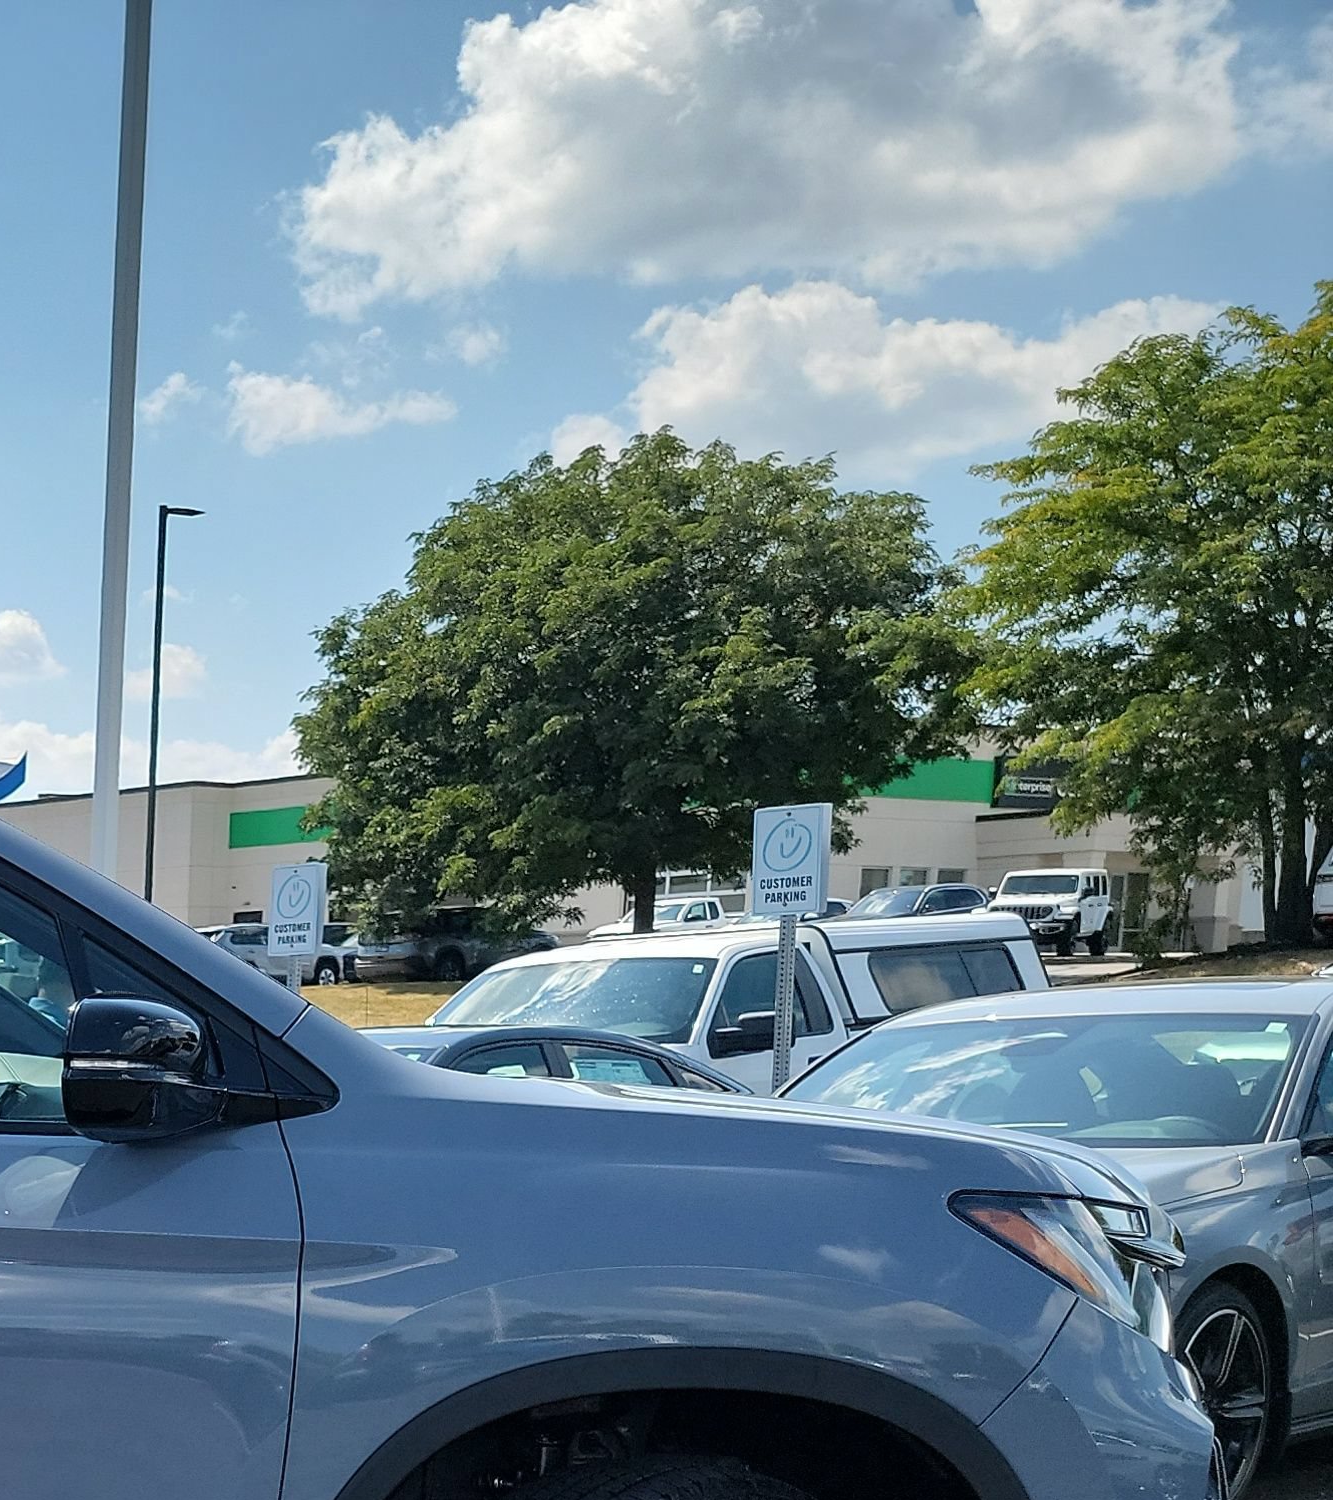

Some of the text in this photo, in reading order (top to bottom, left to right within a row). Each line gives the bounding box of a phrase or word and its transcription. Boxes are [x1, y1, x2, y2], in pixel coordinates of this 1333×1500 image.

[760, 876, 812, 889] CUSTOMER
[764, 890, 807, 904] PARKING
[275, 923, 311, 933] CUSTOMER
[277, 934, 307, 945] PARKING
